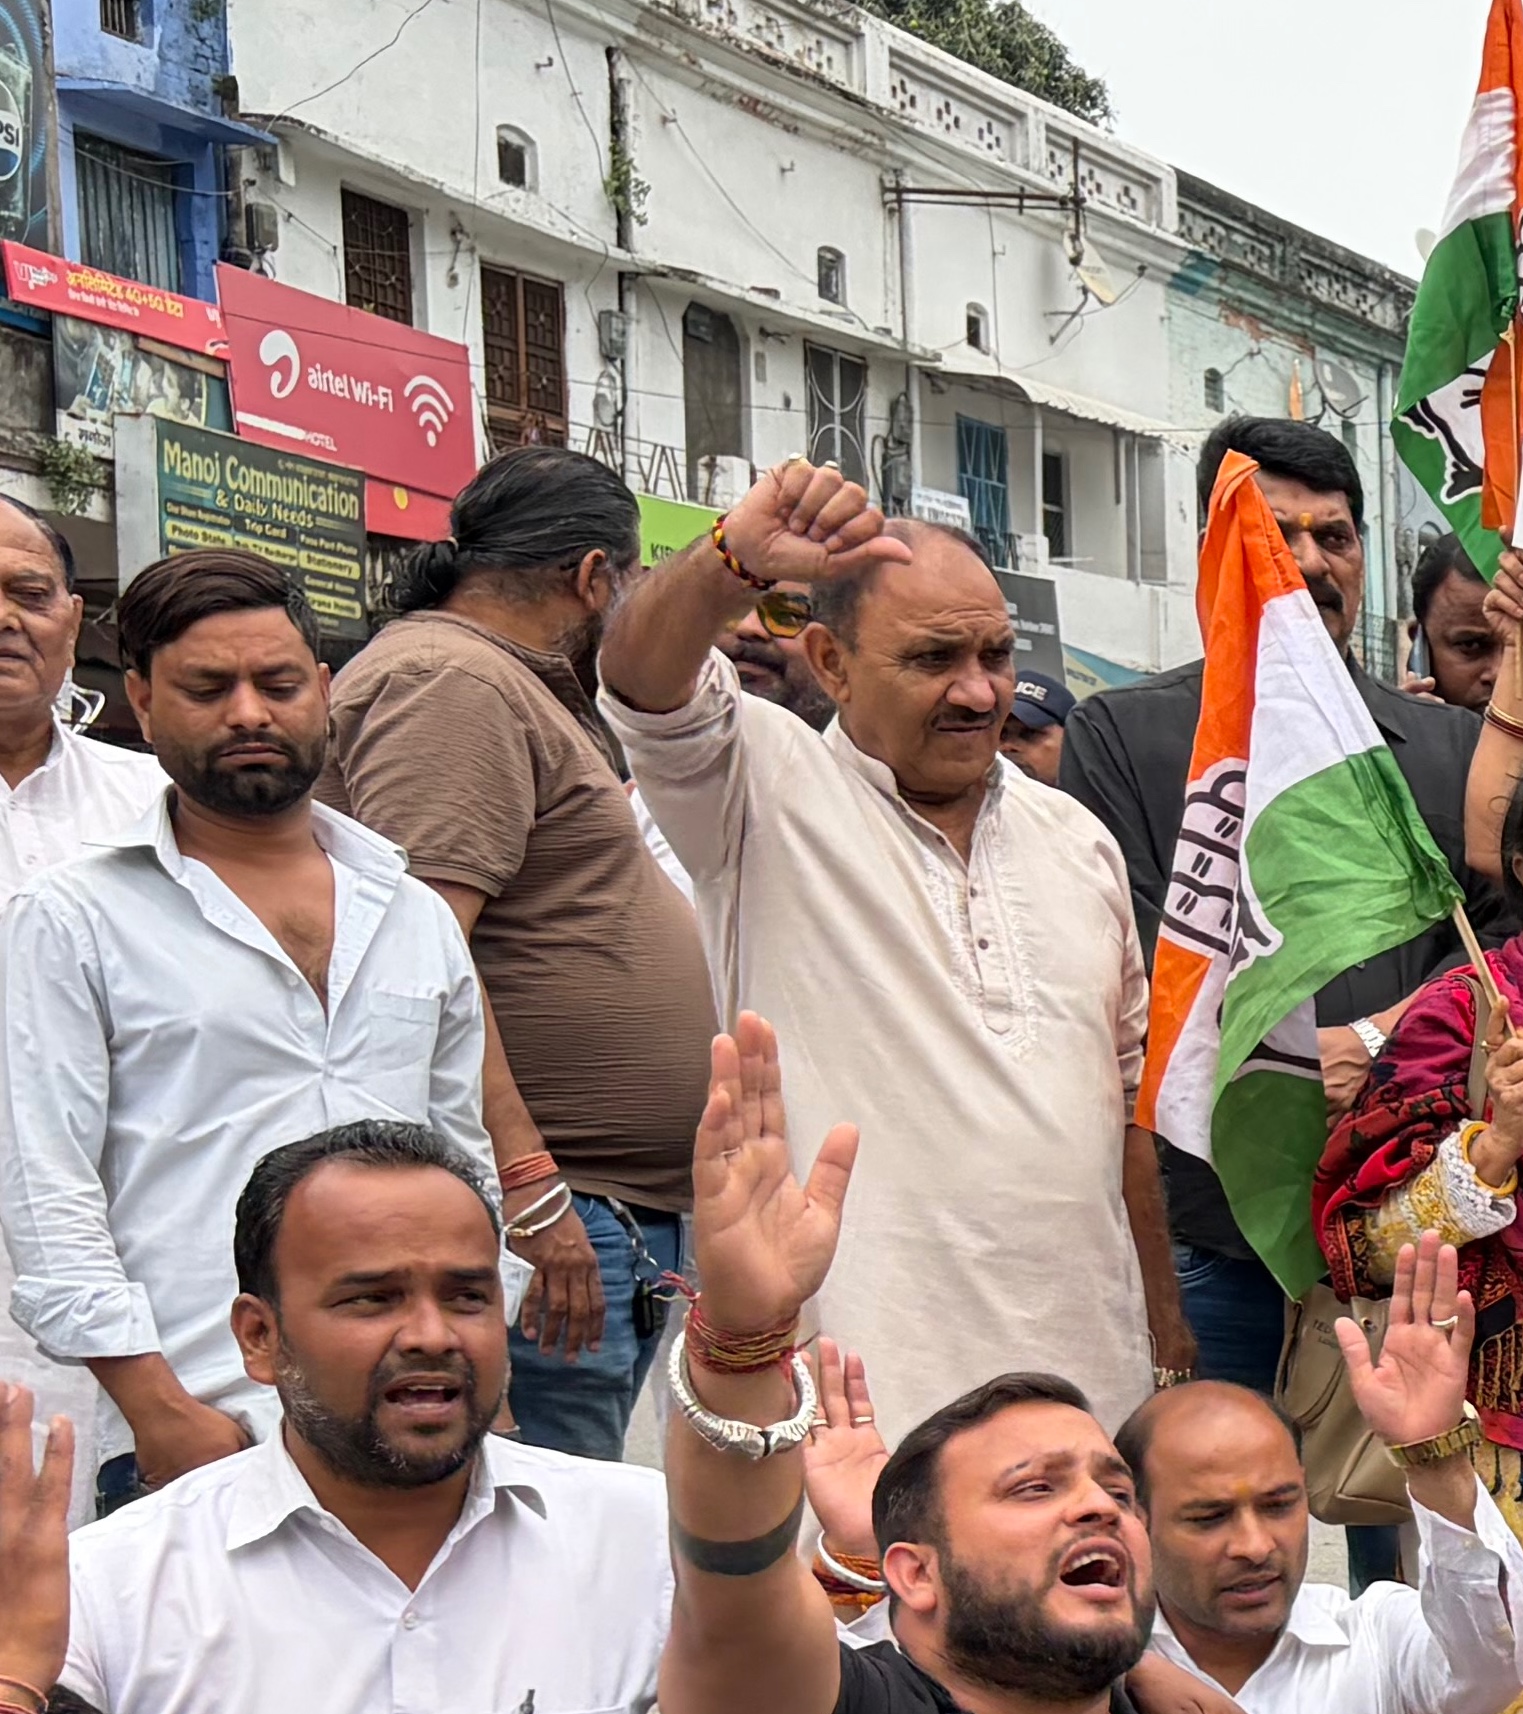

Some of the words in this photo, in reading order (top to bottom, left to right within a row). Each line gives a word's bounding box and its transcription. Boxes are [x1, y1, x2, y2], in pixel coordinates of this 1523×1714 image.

[308, 363, 350, 399] airtel
[350, 377, 394, 413] Wi-Fi
[164, 439, 221, 486] Manoj
[225, 455, 360, 521] Communication
[216, 489, 230, 508] &
[234, 493, 268, 518] Daily
[272, 502, 314, 529] Needs
[1014, 680, 1048, 702] ICE
